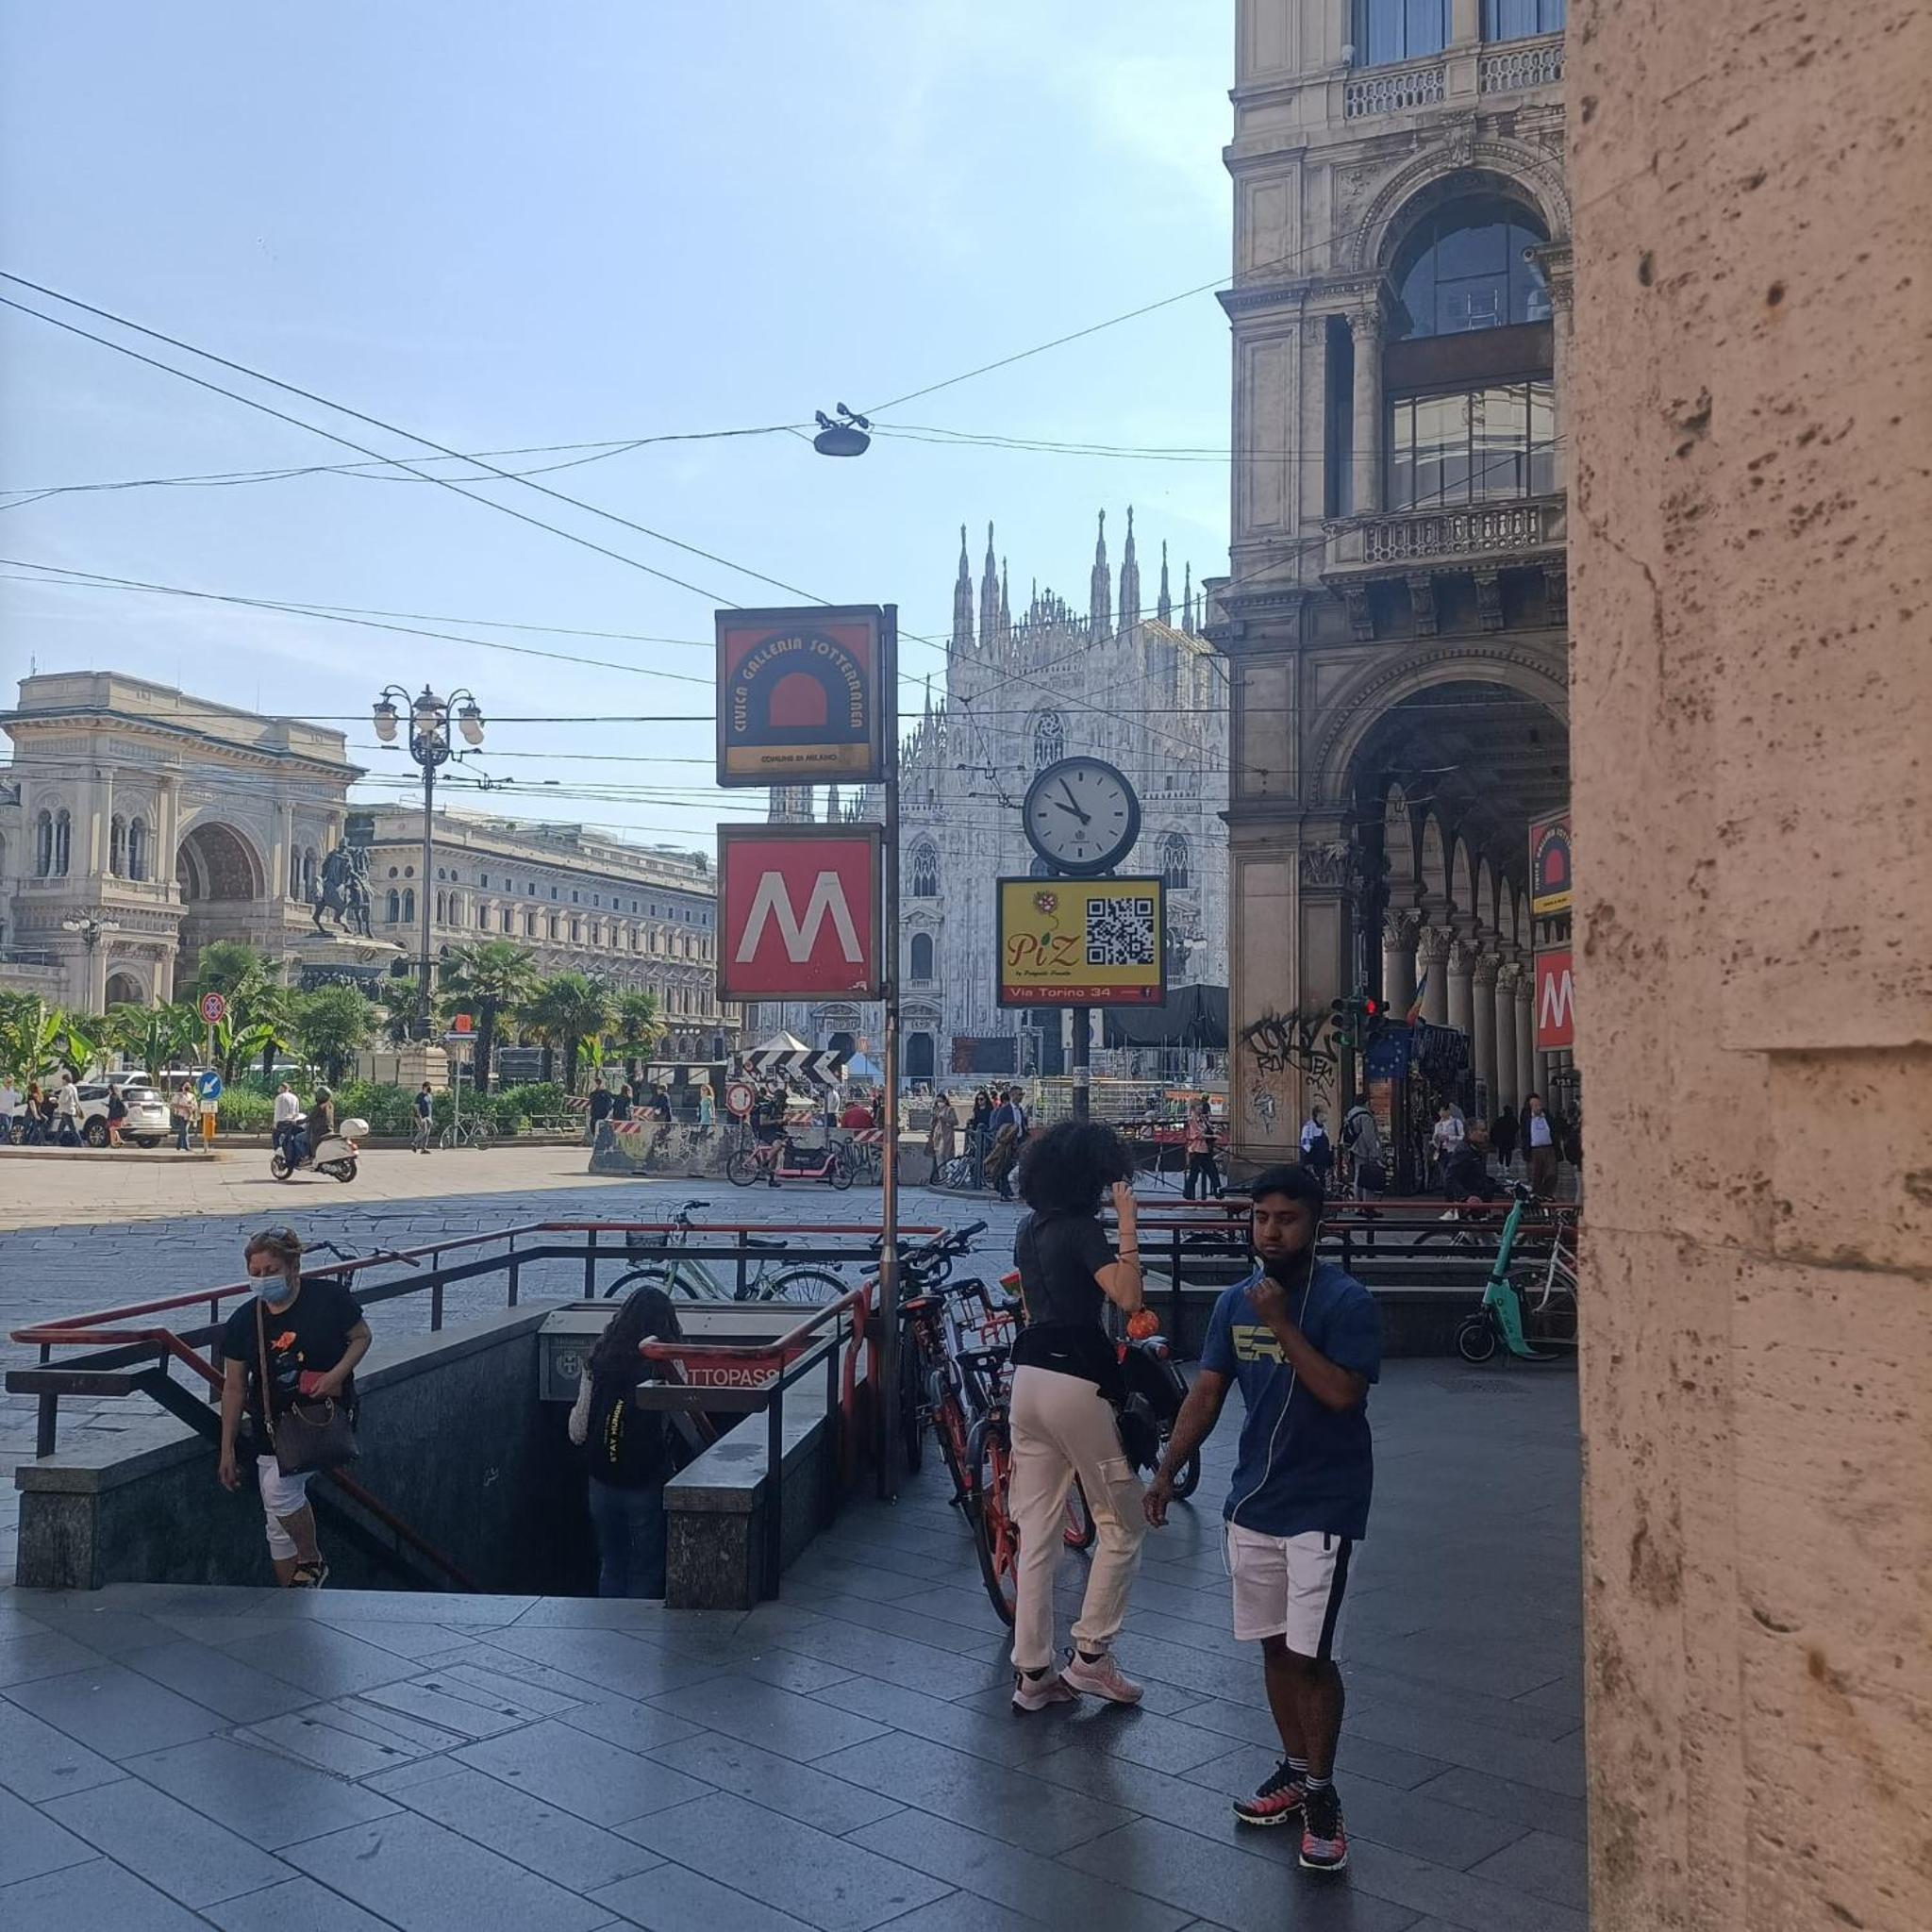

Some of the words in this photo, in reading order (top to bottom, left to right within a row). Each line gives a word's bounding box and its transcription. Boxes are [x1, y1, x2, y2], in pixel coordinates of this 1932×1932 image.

[734, 871, 865, 963] M
[1009, 988, 1033, 997] Via
[1039, 988, 1085, 997] Torino
[1091, 988, 1110, 997] 34
[1540, 969, 1574, 1029] M
